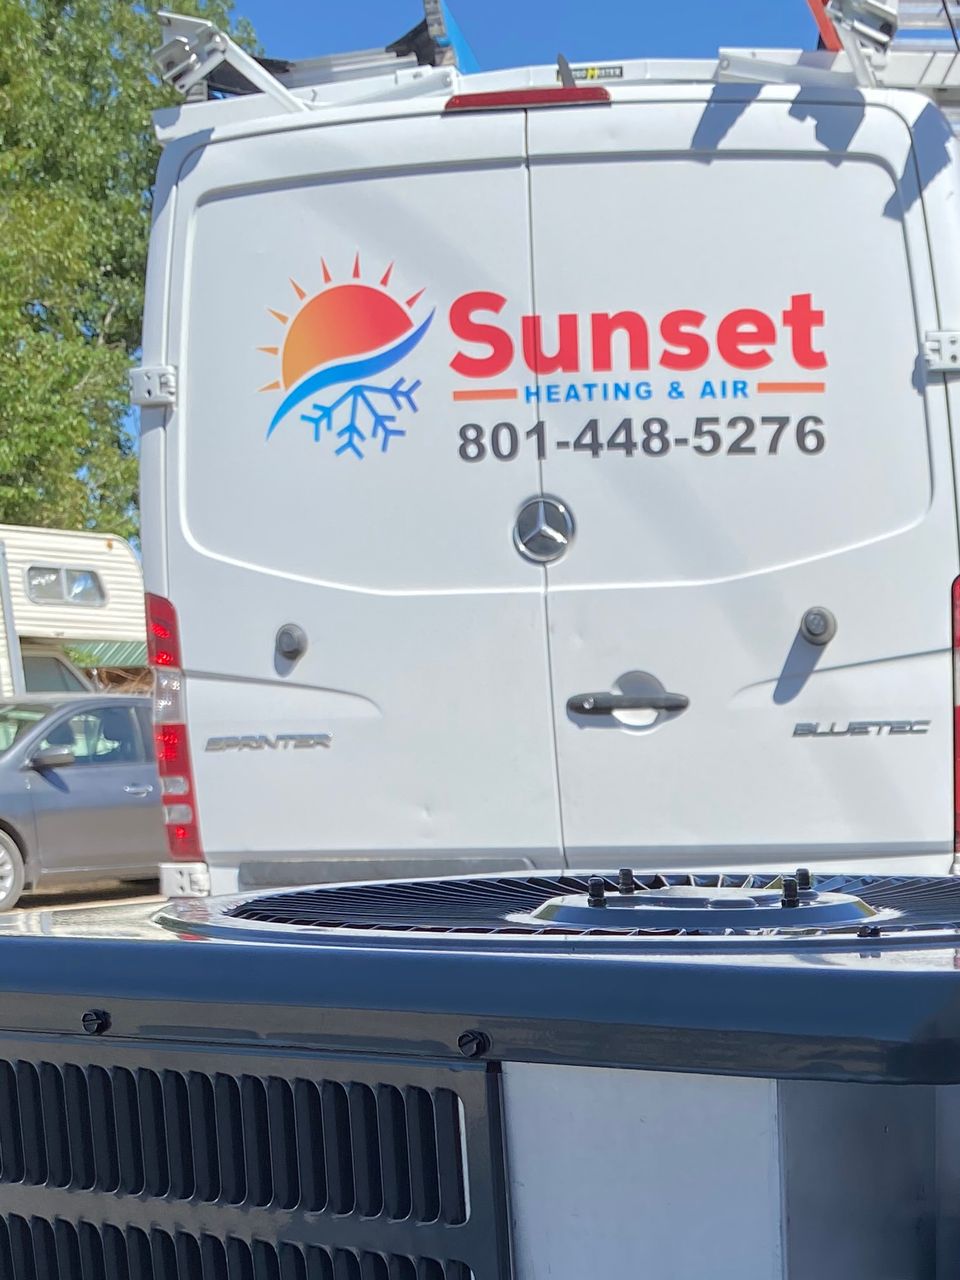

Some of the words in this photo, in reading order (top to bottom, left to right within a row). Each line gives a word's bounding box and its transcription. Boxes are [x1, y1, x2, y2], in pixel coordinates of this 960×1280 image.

[448, 291, 828, 378] Sunset
[525, 381, 653, 403] HEATING
[667, 380, 685, 399] &
[700, 379, 749, 399] AIR
[457, 415, 827, 463] 801-448-5276
[792, 720, 932, 737] BLUETEC
[205, 734, 331, 752] SPRINTER
